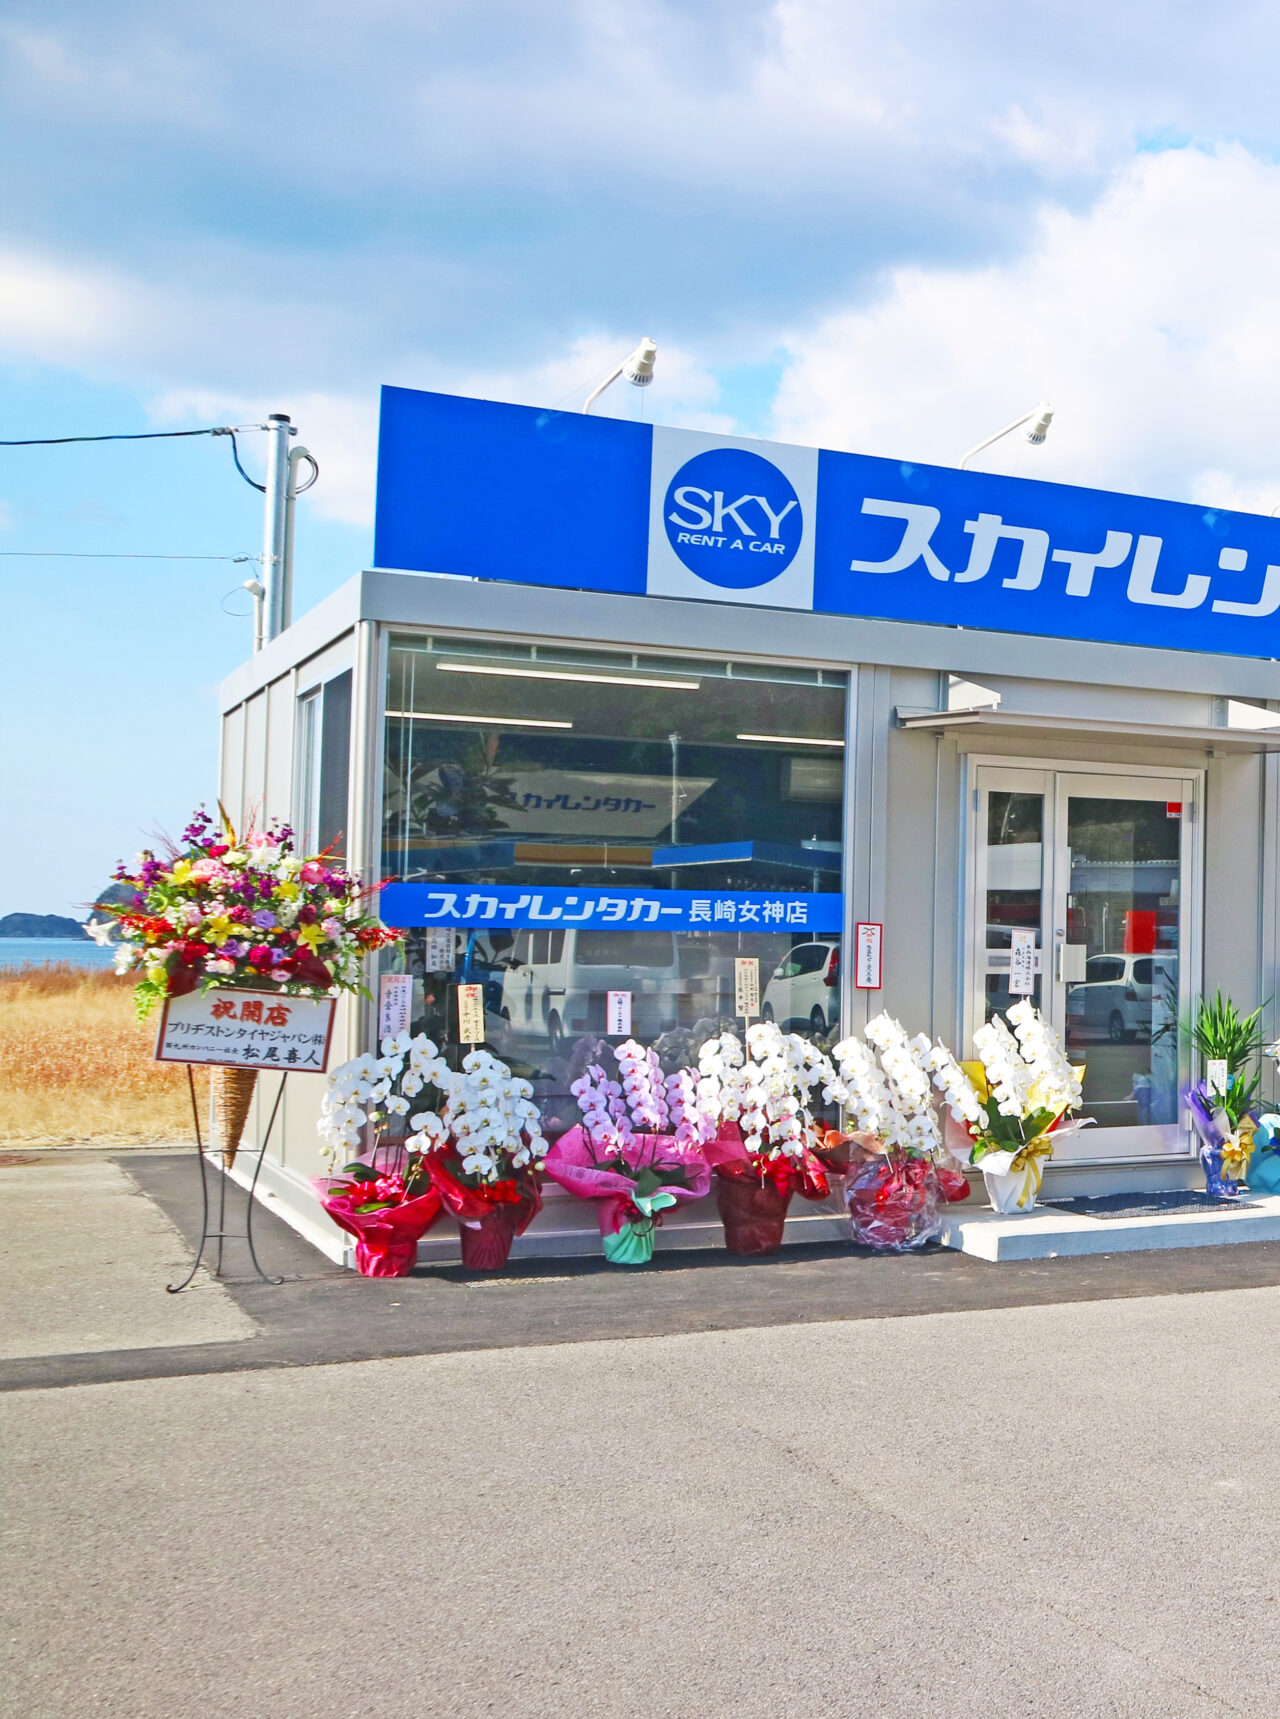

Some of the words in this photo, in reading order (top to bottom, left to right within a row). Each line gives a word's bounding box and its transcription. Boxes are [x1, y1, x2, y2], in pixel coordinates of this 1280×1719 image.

[668, 486, 798, 539] SKY
[677, 532, 727, 548] RENT
[730, 539, 744, 550] A
[749, 541, 786, 555] CAR
[424, 892, 682, 922] スカイレンタカー
[688, 899, 808, 924] 長崎女神店
[210, 998, 293, 1027] 祝開店
